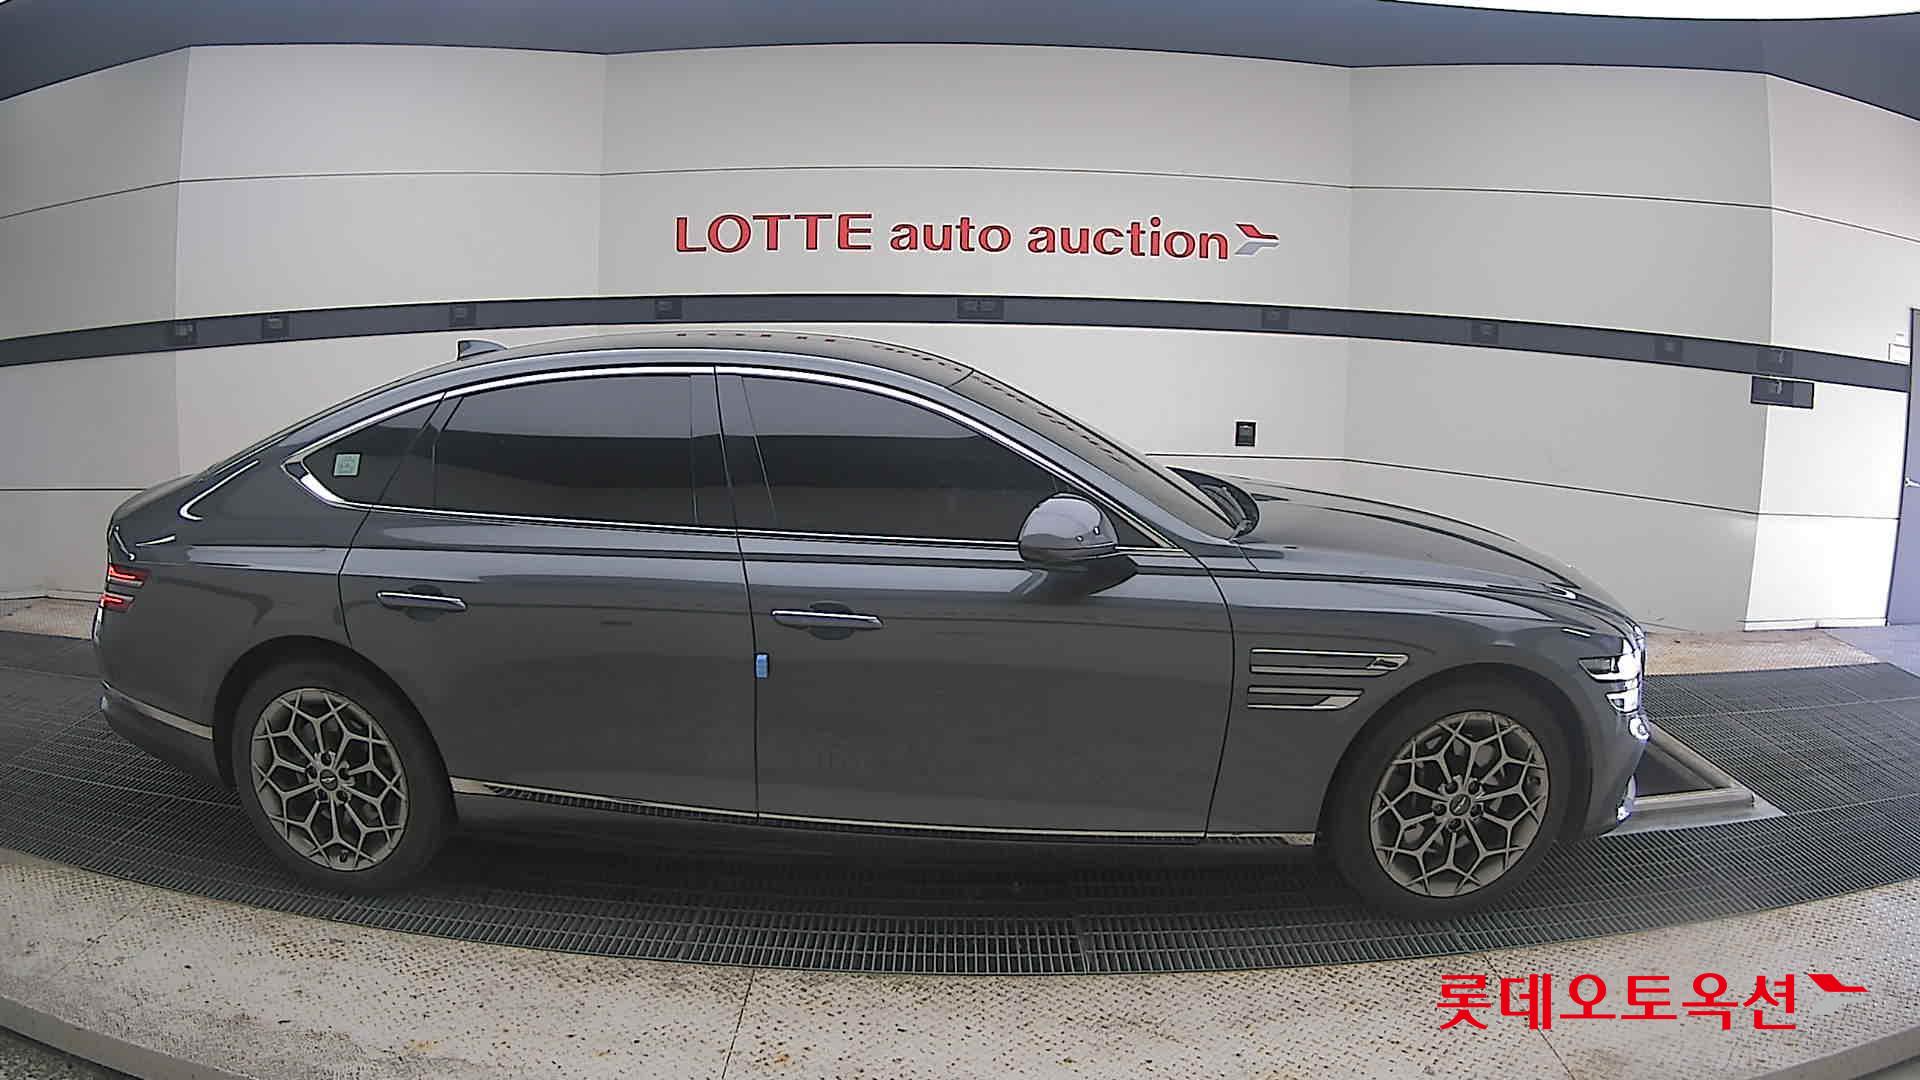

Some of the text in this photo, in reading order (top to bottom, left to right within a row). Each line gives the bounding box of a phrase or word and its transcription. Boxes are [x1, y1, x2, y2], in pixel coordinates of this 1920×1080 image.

[676, 214, 1229, 260] LOTTE auto auction
